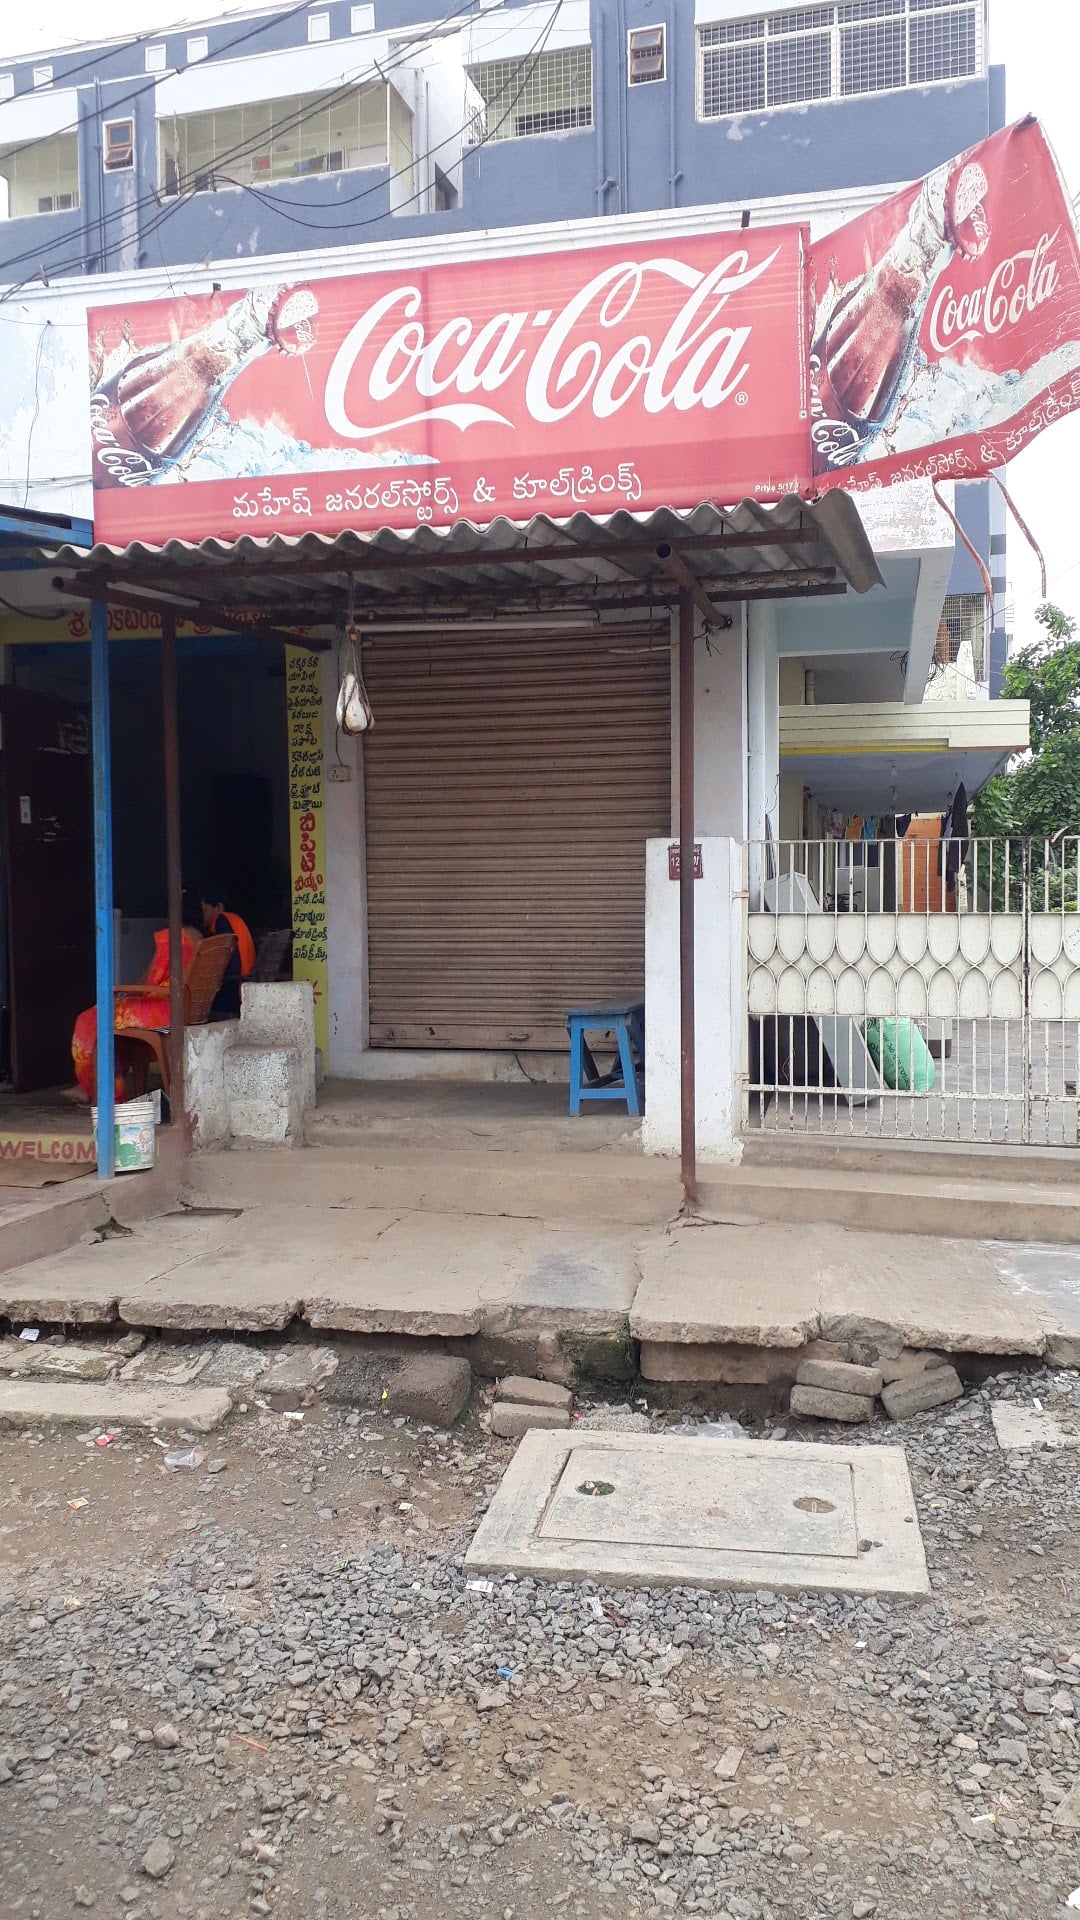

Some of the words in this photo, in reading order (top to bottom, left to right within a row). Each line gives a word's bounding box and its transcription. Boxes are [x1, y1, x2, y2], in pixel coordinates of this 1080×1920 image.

[929, 224, 1062, 352] Coca-Cola
[324, 245, 783, 438] Coca-Cola
[89, 393, 163, 488] Coca-Cola
[810, 353, 868, 465] Coca-Cola
[980, 444, 997, 463] &
[232, 486, 313, 518] మహేష్
[473, 476, 496, 503] &
[0, 1140, 97, 1160] WELCOM
